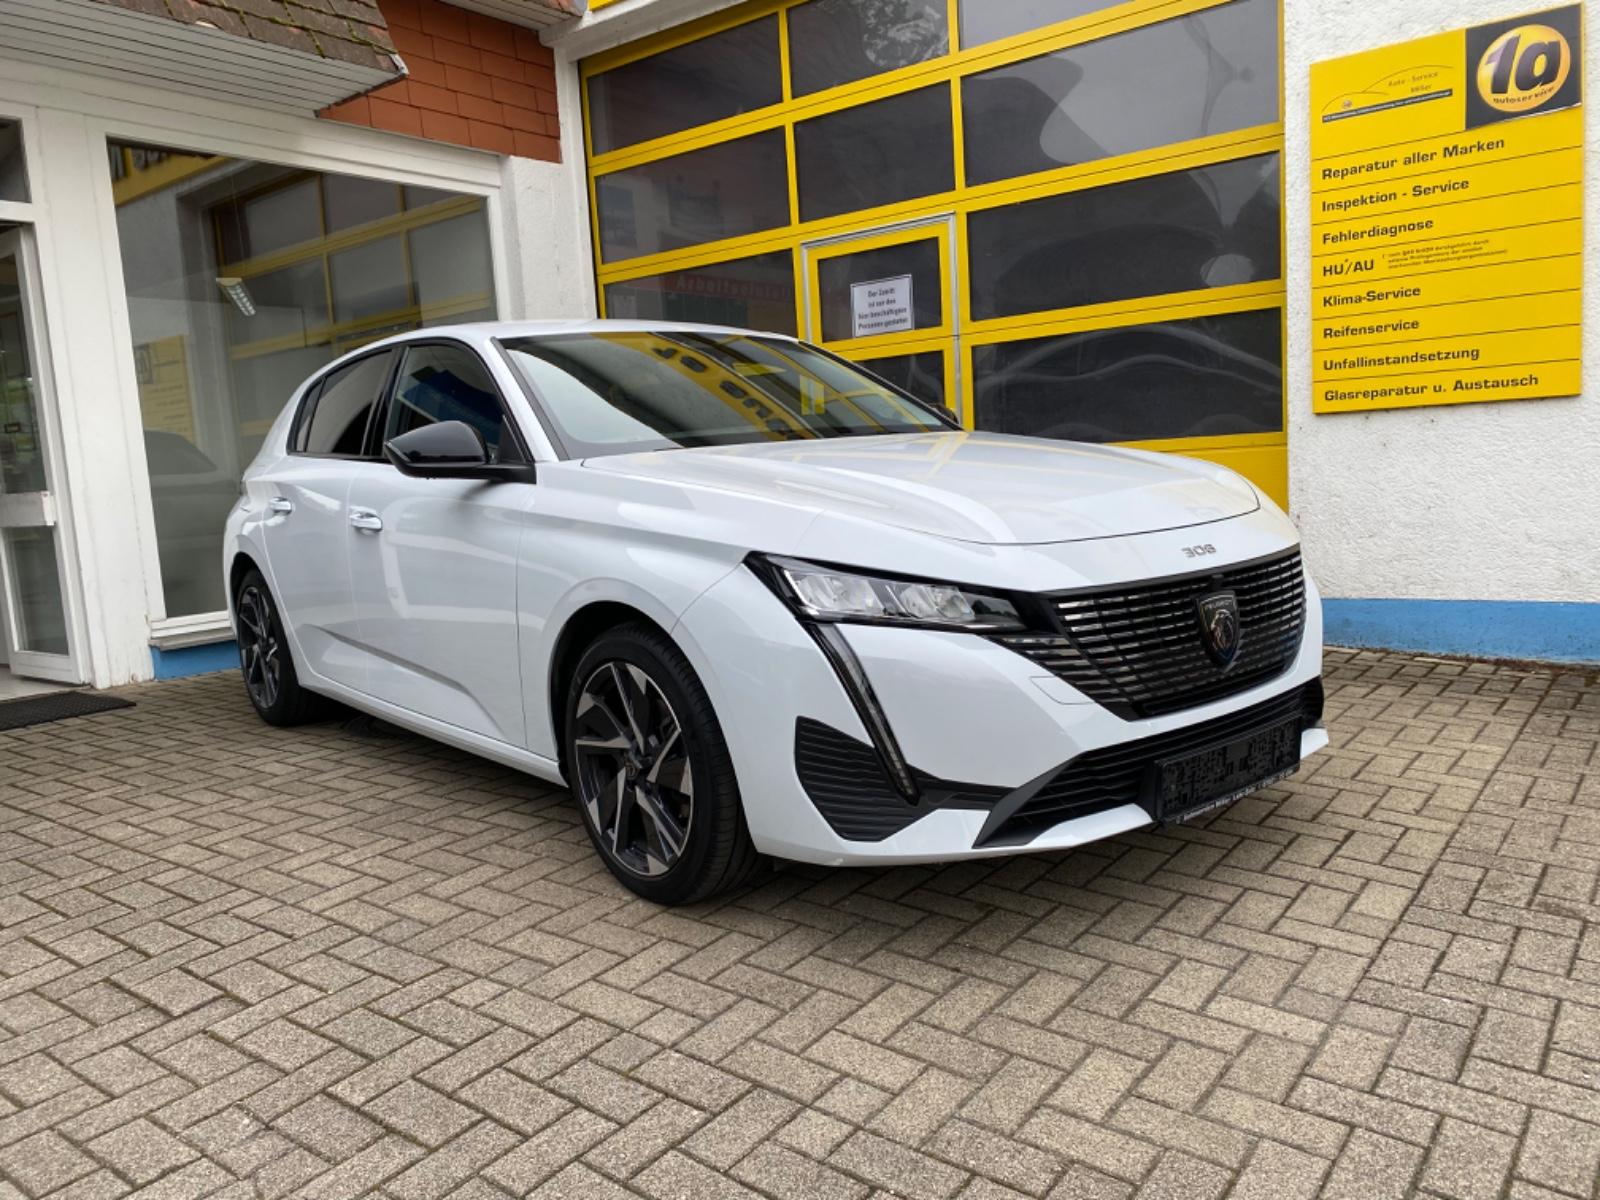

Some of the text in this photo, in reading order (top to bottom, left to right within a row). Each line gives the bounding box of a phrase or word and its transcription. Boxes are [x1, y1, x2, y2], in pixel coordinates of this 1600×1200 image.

[1485, 34, 1560, 94] 1a
[1493, 86, 1554, 104] autoservice
[1322, 138, 1505, 180] Reparatur aller Marken
[1322, 189, 1397, 212] Inspektion
[1412, 179, 1469, 197] Service
[1323, 219, 1434, 244] Fehlerdiagnose
[1323, 286, 1421, 307] Klima-Service
[1323, 320, 1419, 339] Reifenservice
[1323, 348, 1480, 371] Unfallinstandsetzung
[1324, 374, 1538, 402] Glasreparatur u. Austausch
[1182, 544, 1216, 558] 308
